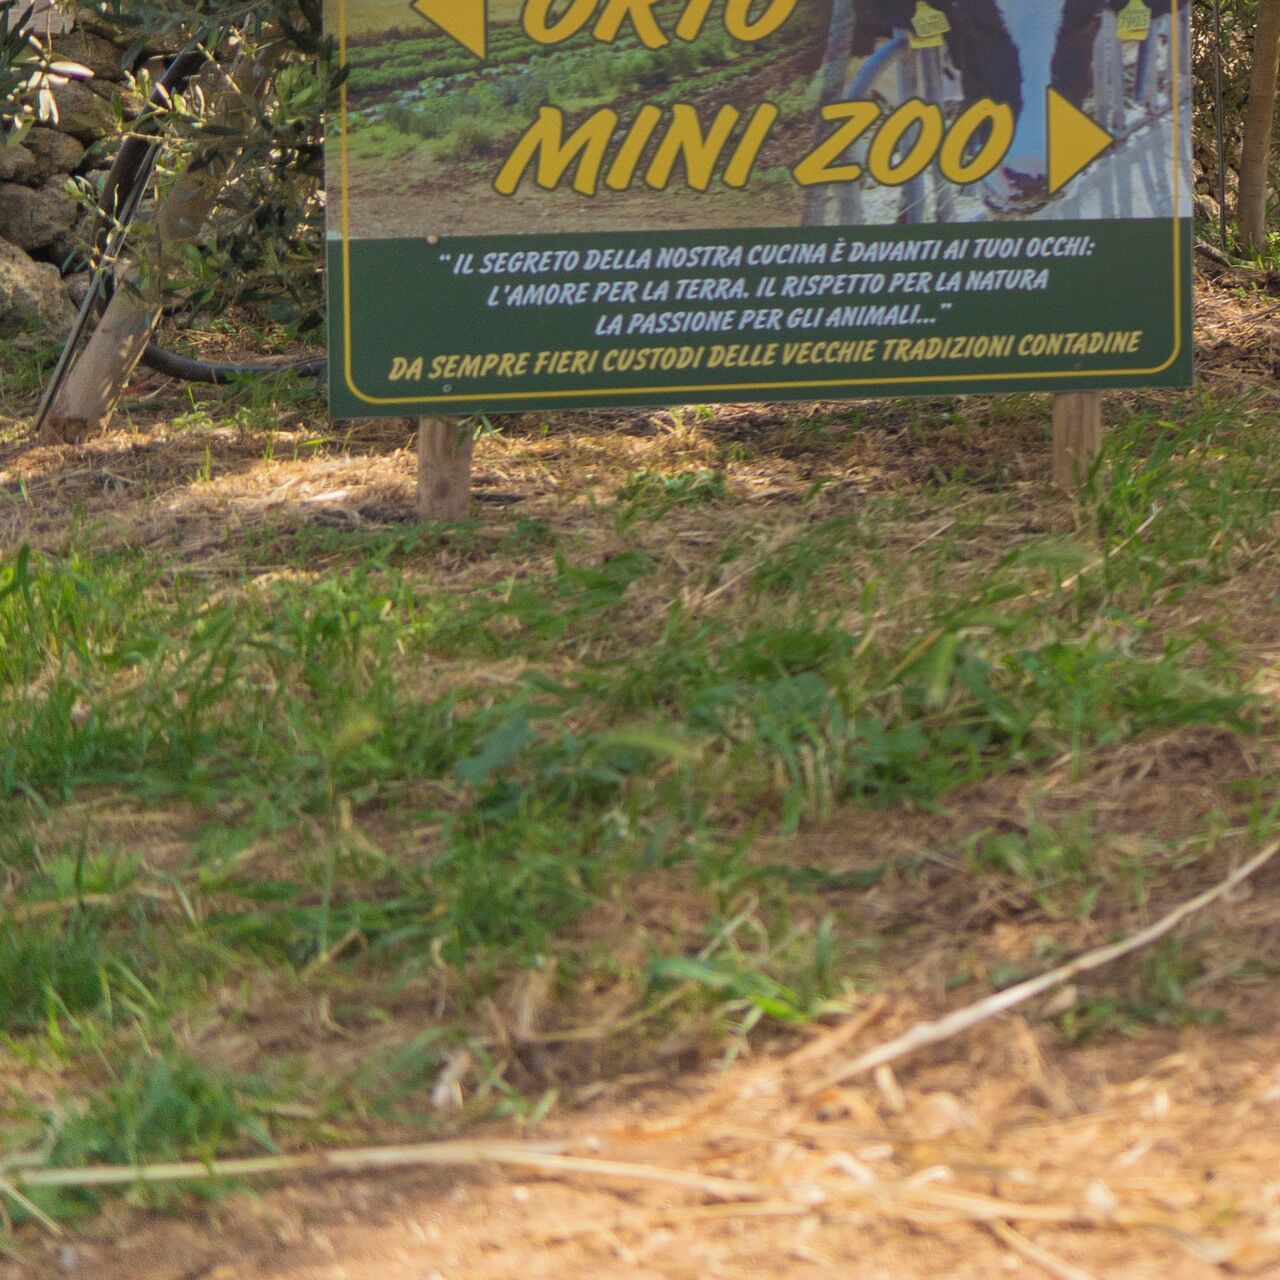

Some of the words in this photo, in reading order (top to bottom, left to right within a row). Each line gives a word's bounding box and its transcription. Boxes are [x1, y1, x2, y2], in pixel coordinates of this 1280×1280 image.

[493, 102, 780, 197] MINI
[792, 97, 1016, 186] ZOO
[479, 250, 580, 273] SEGRETO
[582, 248, 652, 271] DELLA
[655, 245, 743, 269] NOSTRA
[746, 242, 828, 265] CUCINA
[830, 238, 845, 263] È
[847, 239, 942, 263] DAVANTI
[943, 239, 968, 261] AI
[972, 237, 1023, 259] TUOI
[1025, 236, 1096, 257] OCCHI:
[487, 283, 590, 307] L'AMORE
[592, 281, 637, 303] PER
[641, 280, 670, 301] LA
[675, 278, 750, 300] TERRA.
[755, 277, 777, 297] IL
[780, 273, 885, 297] RISPETTO
[887, 271, 931, 294] PER
[935, 271, 961, 292] LA
[965, 269, 1050, 291] NATURA
[594, 314, 622, 337] LA
[626, 310, 738, 336] PASSIONE
[737, 309, 783, 332] PER
[786, 306, 823, 329] GLI
[388, 355, 424, 381] DA
[427, 351, 531, 379] SEMPRE
[533, 350, 600, 375] FIERI
[602, 346, 705, 372] CUSTODI
[708, 344, 778, 368] DELLE
[781, 339, 879, 365] VECCHIE
[882, 334, 1016, 363] TRADIZIONI
[1018, 330, 1143, 356] CONTADINE
